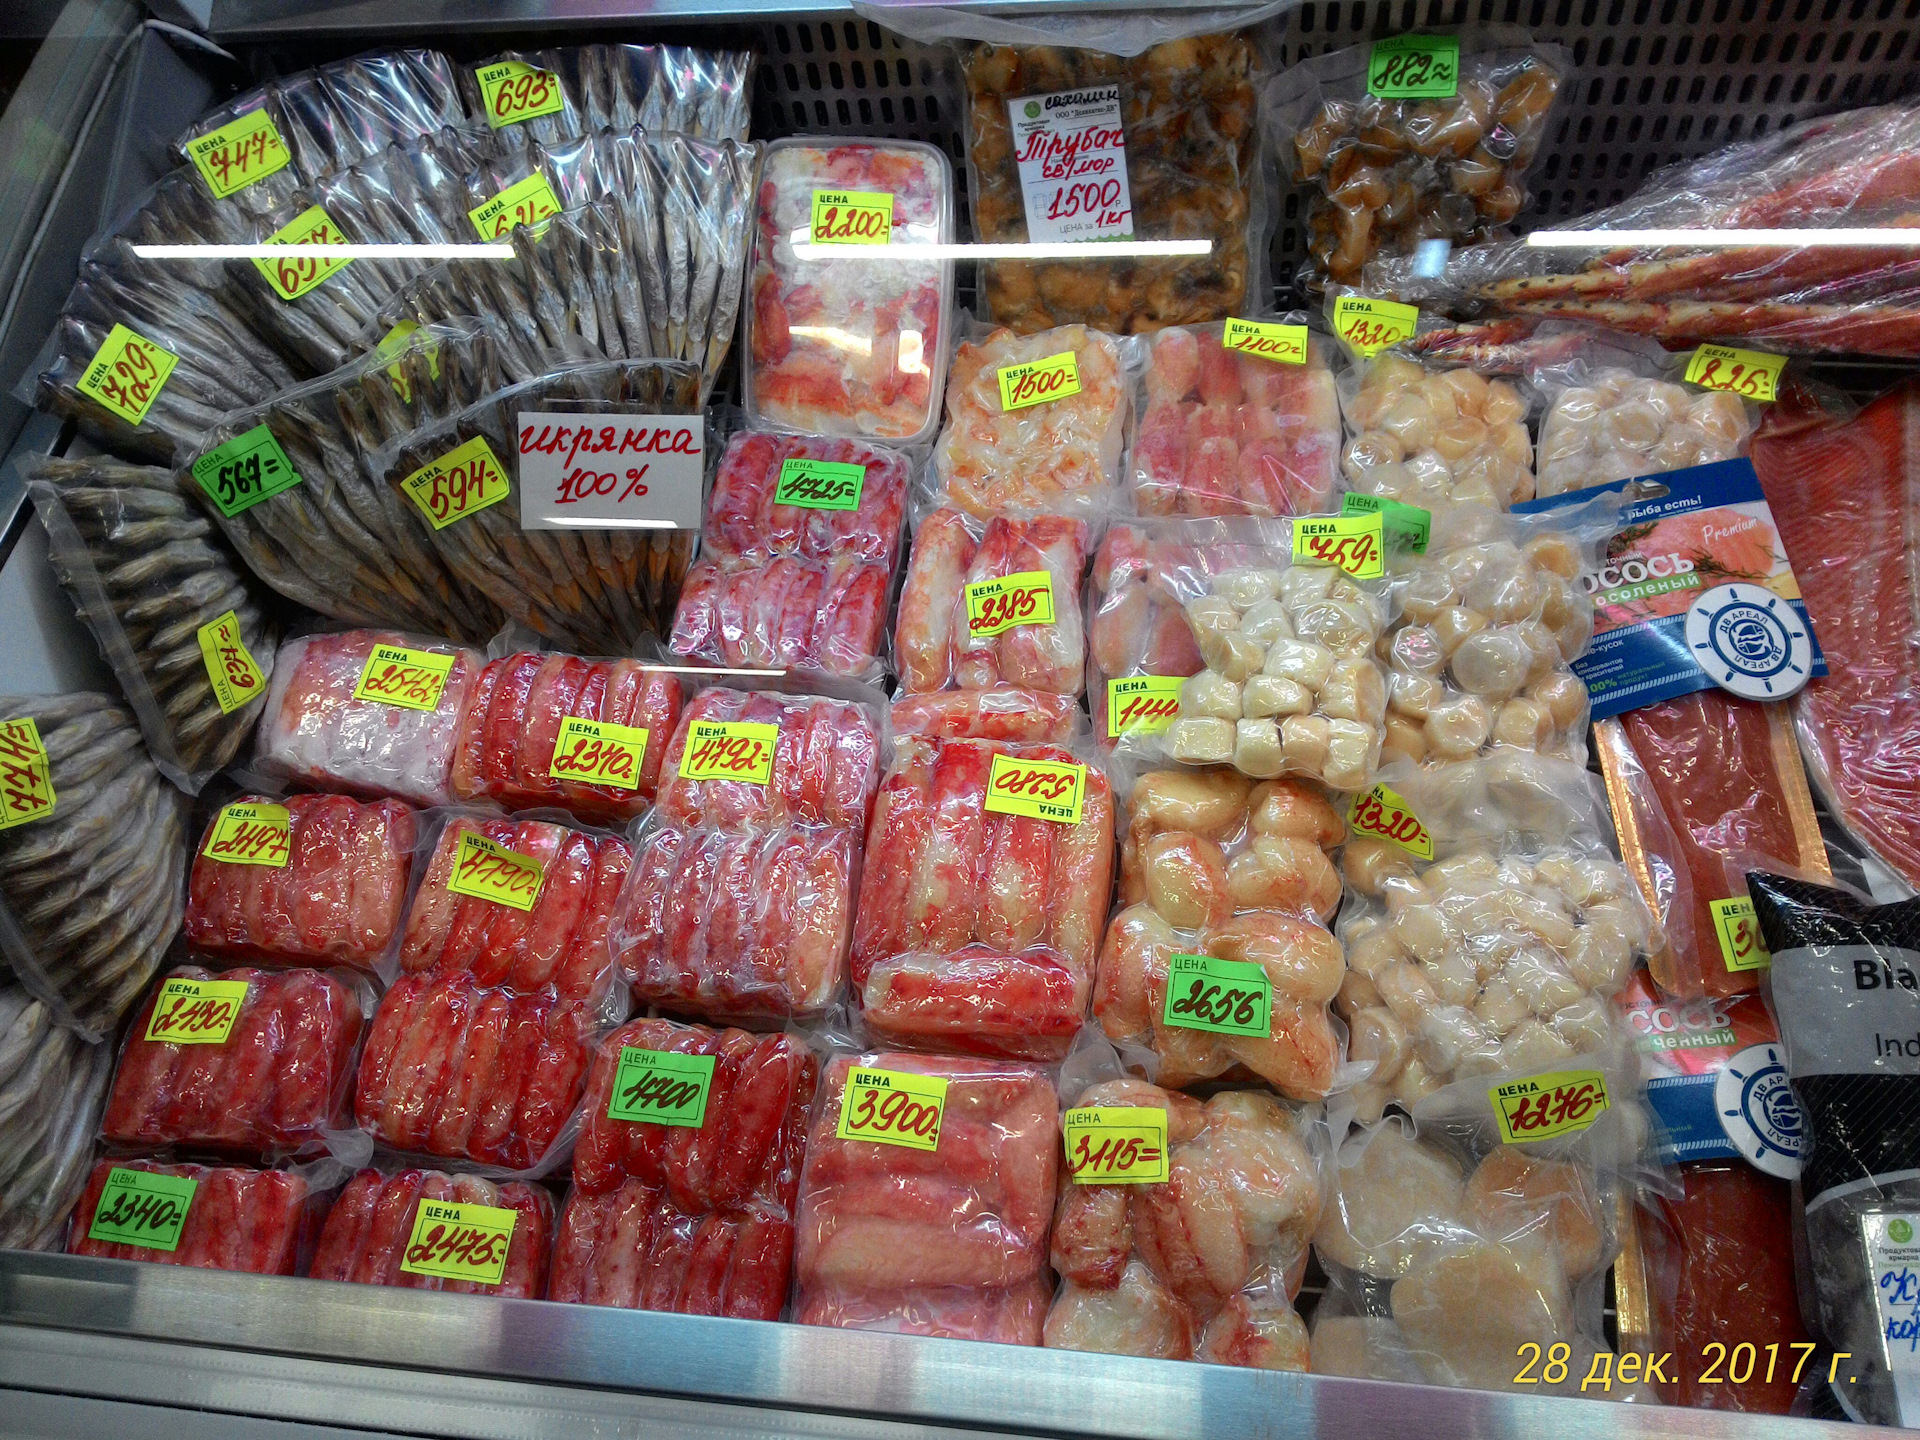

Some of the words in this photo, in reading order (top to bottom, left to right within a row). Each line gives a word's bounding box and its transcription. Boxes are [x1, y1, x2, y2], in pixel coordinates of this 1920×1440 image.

[483, 67, 511, 81] ЦЕНА
[1055, 111, 1070, 120] ООО
[195, 135, 226, 154] ЦЕНА
[1015, 126, 1128, 169] Трубач
[819, 194, 849, 204] ЦЕНА
[1047, 179, 1121, 220] 1500
[479, 200, 506, 221] ЦЕНА
[1059, 222, 1083, 234] ЦЕНА
[1342, 301, 1372, 312] ЦЕНА
[1232, 323, 1260, 335] ЦЕНА
[1704, 348, 1736, 359] ЦЕНА
[87, 361, 109, 390] ЦЕНА
[1005, 365, 1035, 379] ЦЕНА
[519, 425, 702, 471] икрянка
[192, 451, 224, 475] ЦЕНА
[786, 461, 813, 469] ЦЕНА
[409, 465, 444, 489] ЦЕНА
[554, 464, 650, 504] 100%
[1347, 495, 1379, 509] ЦЕНА
[1664, 495, 1703, 512] есть!
[1302, 524, 1337, 534] ЦЕНА
[1702, 516, 1758, 544] Premium
[1582, 552, 1695, 595] ОСОСЬ
[972, 583, 1003, 597] ЦЕНА
[1595, 572, 1700, 606] осоленый
[1719, 618, 1732, 634] ДВ
[1732, 610, 1769, 625] АРЕАЛ
[378, 648, 408, 663] ЦЕНА
[1734, 654, 1771, 669] АРЕАЛ
[1116, 681, 1148, 693] ЦЕНА
[1588, 677, 1618, 693] 00%
[216, 679, 234, 711] ЦЕНА
[568, 721, 601, 737] ЦЕНА
[697, 726, 728, 737] ЦЕНА
[1371, 786, 1385, 801] НА
[228, 807, 258, 819] ЦЕНА
[1039, 803, 1074, 818] ЦЕНА
[466, 835, 496, 852] ЦЕНА
[1720, 903, 1756, 917] ЦЕН
[1174, 958, 1209, 972] ЦЕНА
[1854, 958, 1920, 990] Bla
[168, 983, 200, 996] ЦЕНА
[1172, 978, 1263, 1026] 2656
[1626, 1002, 1732, 1035] СОСЬ
[1653, 1028, 1736, 1050] ченный
[624, 1051, 656, 1064] ЦЕНА
[855, 1073, 891, 1088] ЦЕНА
[1498, 1081, 1540, 1097] ЦЕНА
[1753, 1083, 1767, 1102] ДВ
[1067, 1112, 1102, 1125] ЦЕНА
[111, 1172, 137, 1186] ЦЕНА
[425, 1205, 461, 1221] ЦЕНА
[1879, 1246, 1920, 1255] Продуктова
